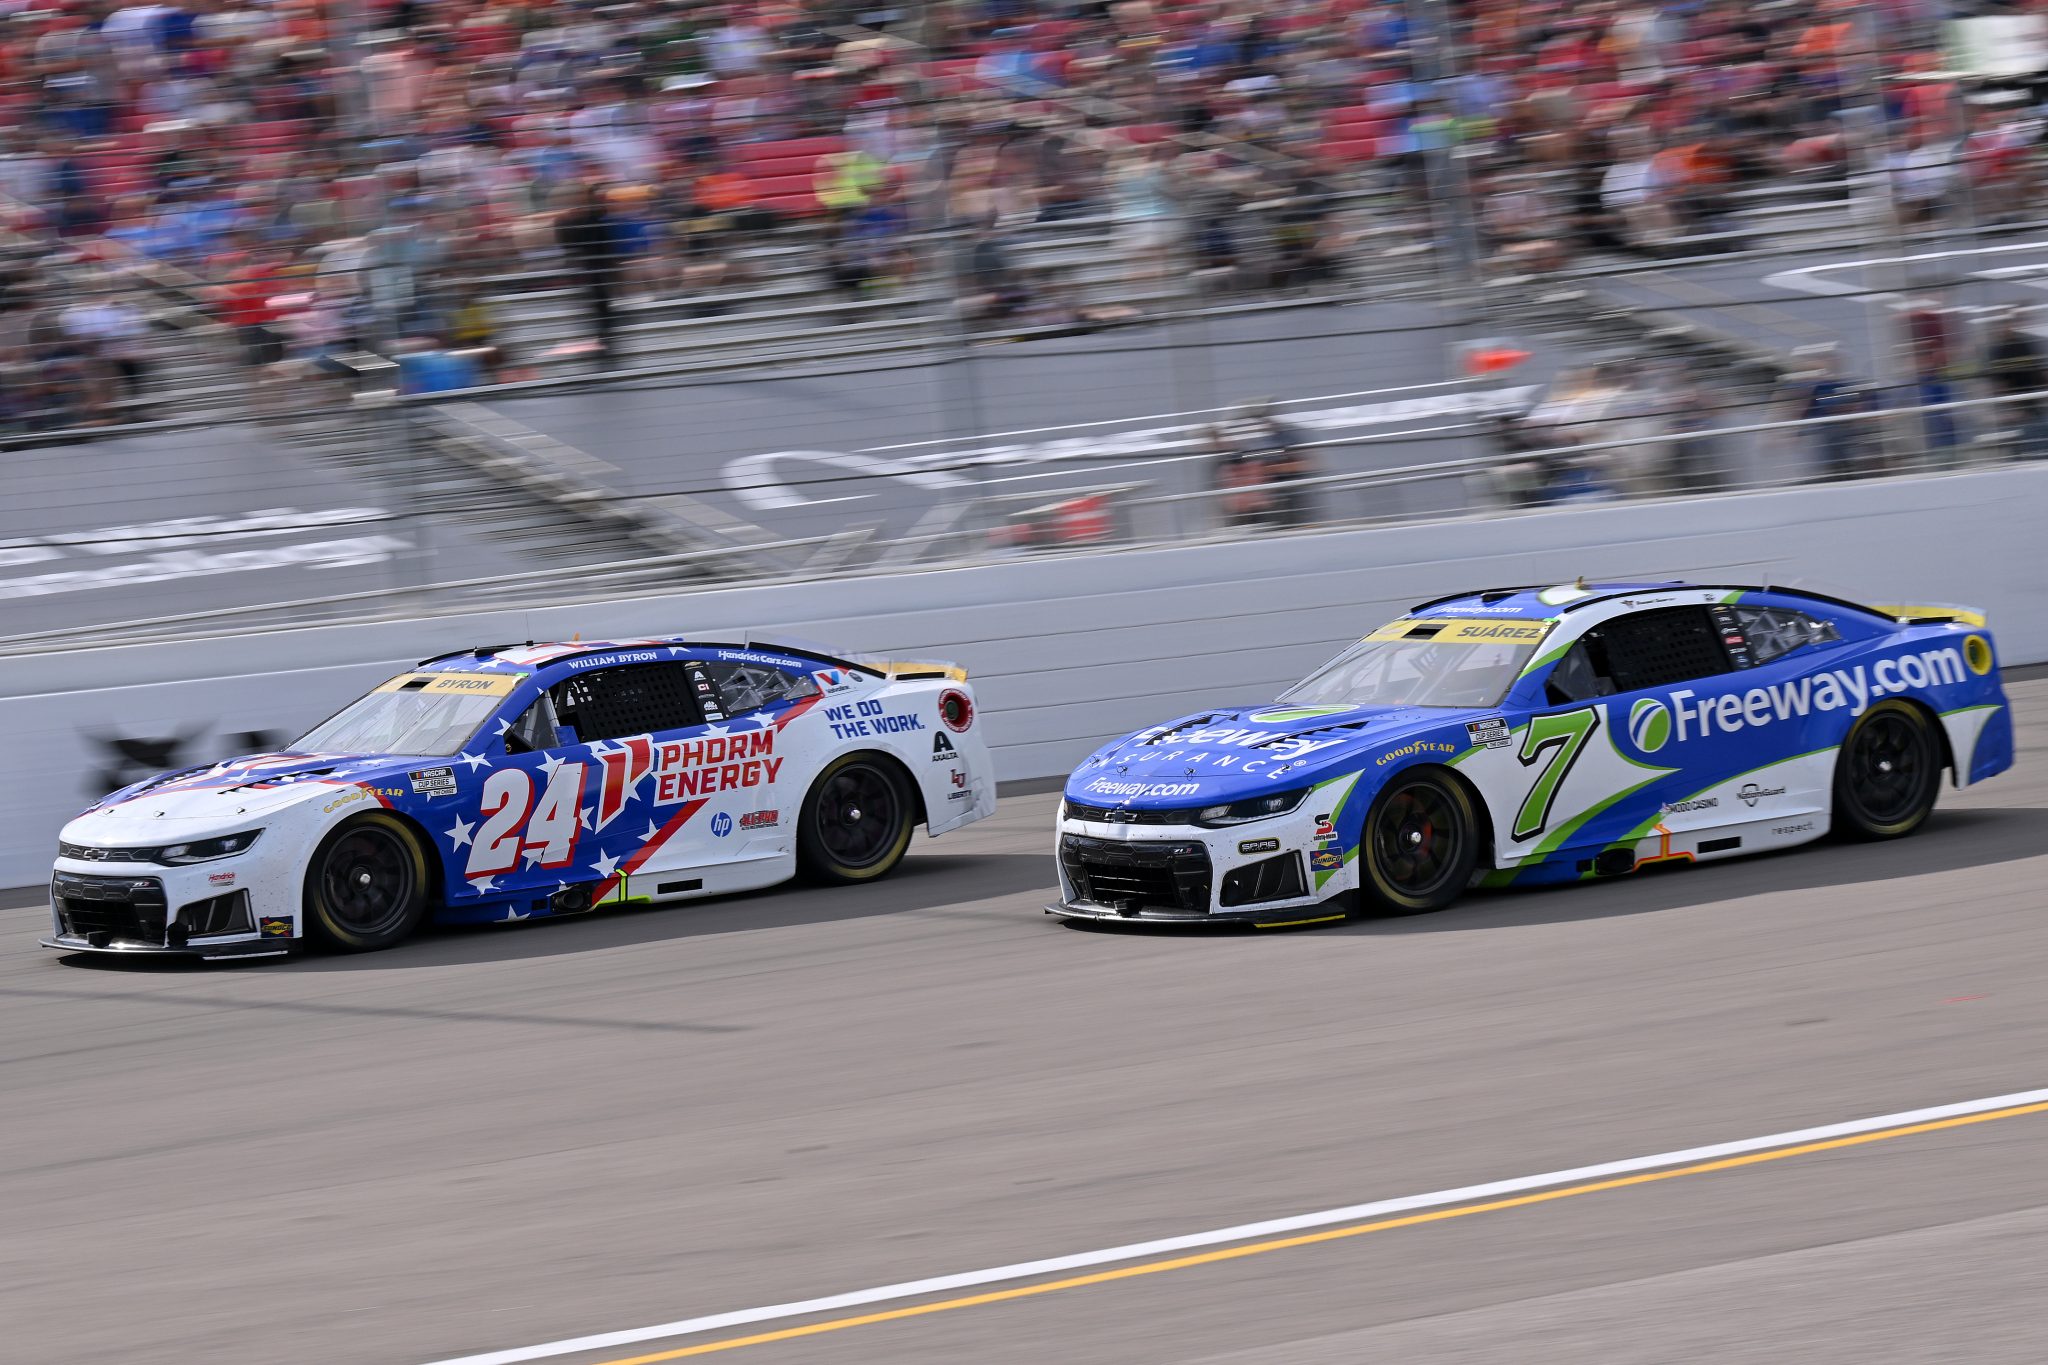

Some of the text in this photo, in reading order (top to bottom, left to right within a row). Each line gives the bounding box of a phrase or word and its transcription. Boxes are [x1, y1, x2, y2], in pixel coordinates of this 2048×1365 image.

[1456, 624, 1540, 638] SUÁREZ
[568, 655, 615, 669] WILLIAM
[618, 652, 658, 663] BYRON
[436, 679, 495, 690] BYRON
[1669, 647, 1967, 742] Freeway.com
[824, 699, 883, 722] WE DO
[829, 713, 926, 740] THE WORK.
[1479, 721, 1501, 730] NASCAR
[1475, 730, 1504, 740] CUP SERIES
[661, 729, 774, 771] PHORM
[932, 752, 958, 761] AXALTA
[1376, 740, 1455, 765] GOODYEAR
[423, 769, 447, 778] NASCAR
[658, 756, 784, 801] ENERGY
[1511, 704, 1601, 843] 7
[430, 778, 450, 787] SERIES
[1084, 776, 1199, 800] Freeway.com
[324, 787, 404, 813] GOODYEAR
[1692, 798, 1719, 810] CASINO
[465, 763, 588, 879] 24
[712, 812, 731, 837] hp
[1242, 840, 1277, 850] SPIRE
[1312, 855, 1343, 864] SUNOCO
[261, 923, 293, 932] SUNOCO
